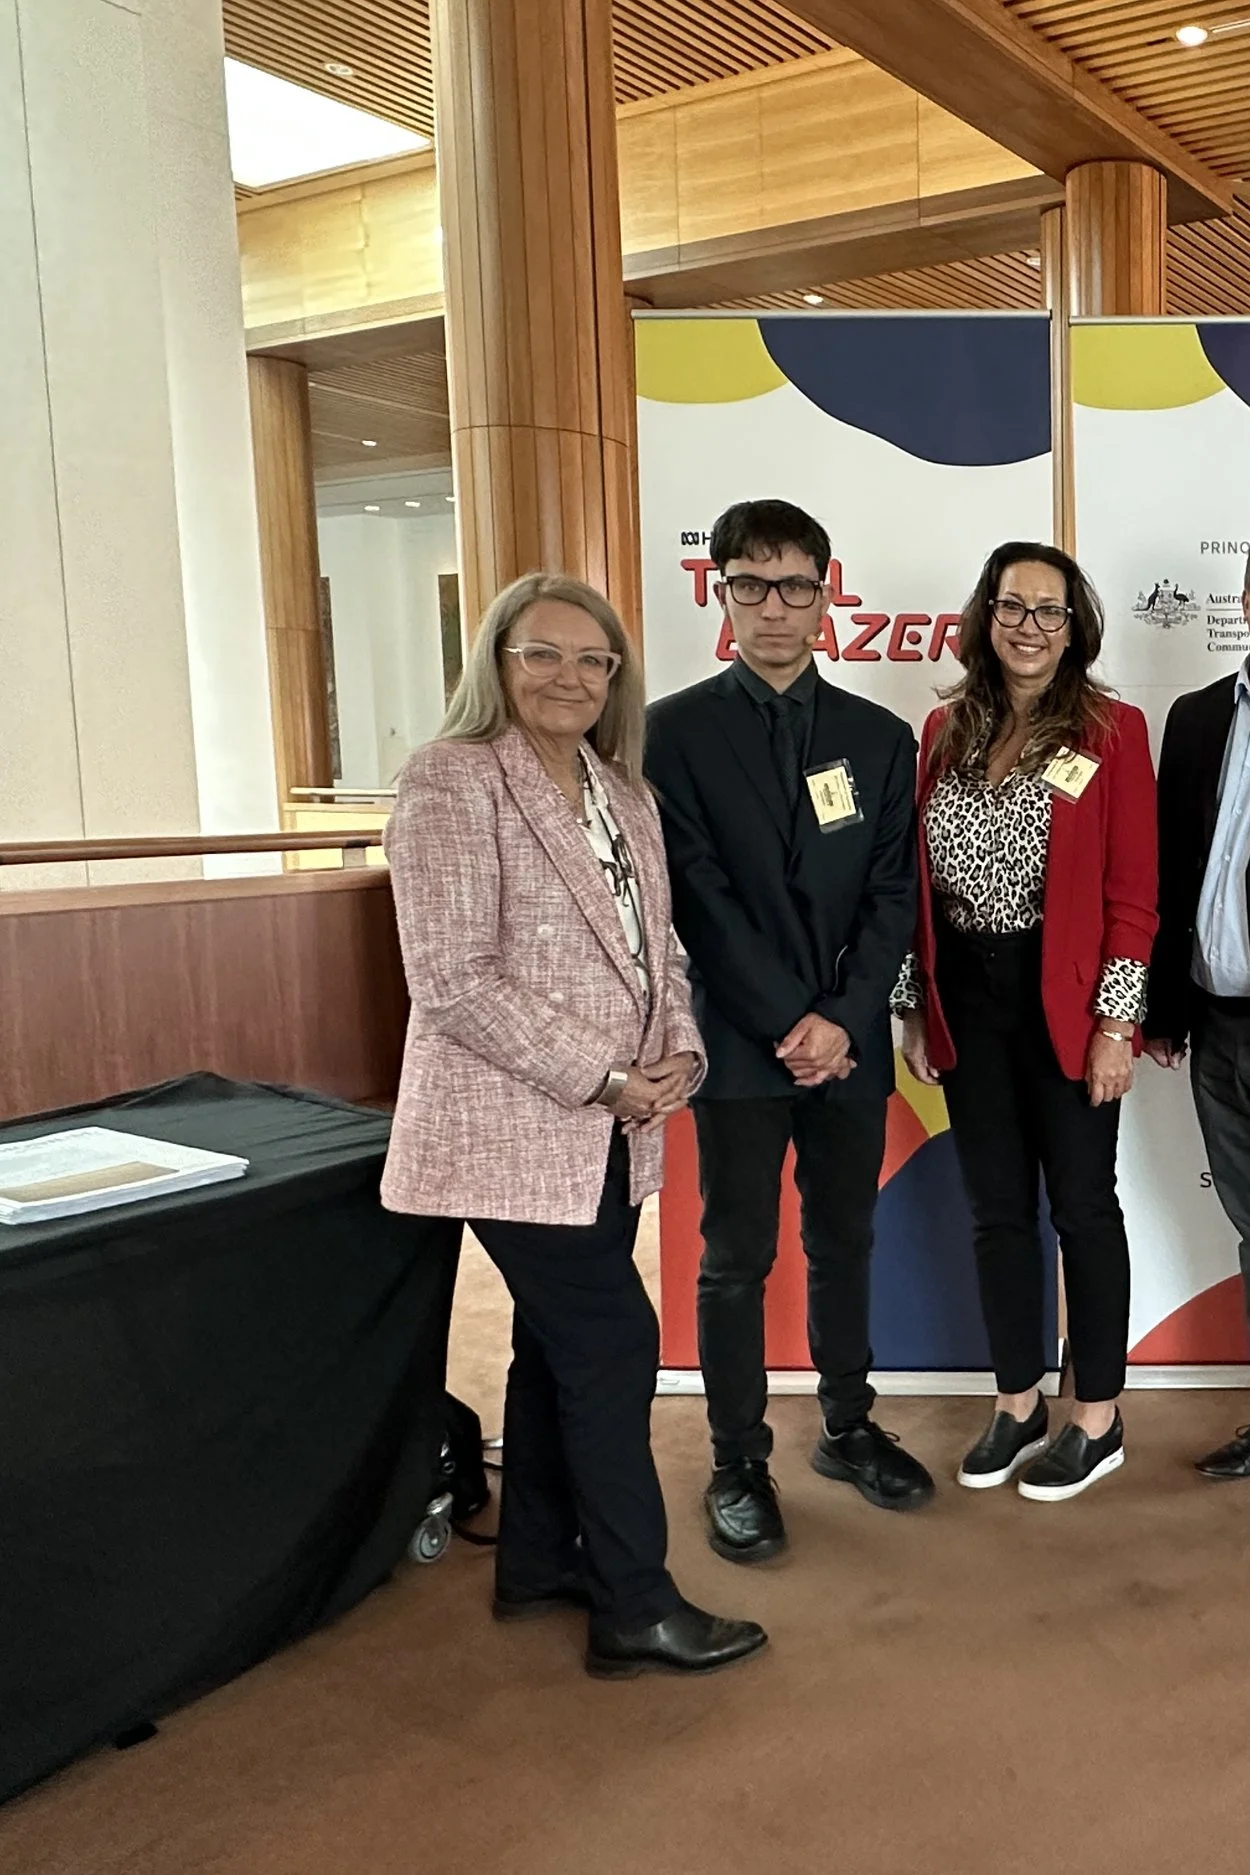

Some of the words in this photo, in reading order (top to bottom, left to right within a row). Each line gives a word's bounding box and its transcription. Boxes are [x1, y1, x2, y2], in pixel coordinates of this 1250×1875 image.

[1200, 541, 1250, 554] PRINC
[1206, 593, 1242, 603] Austr
[1207, 615, 1247, 627] Depart
